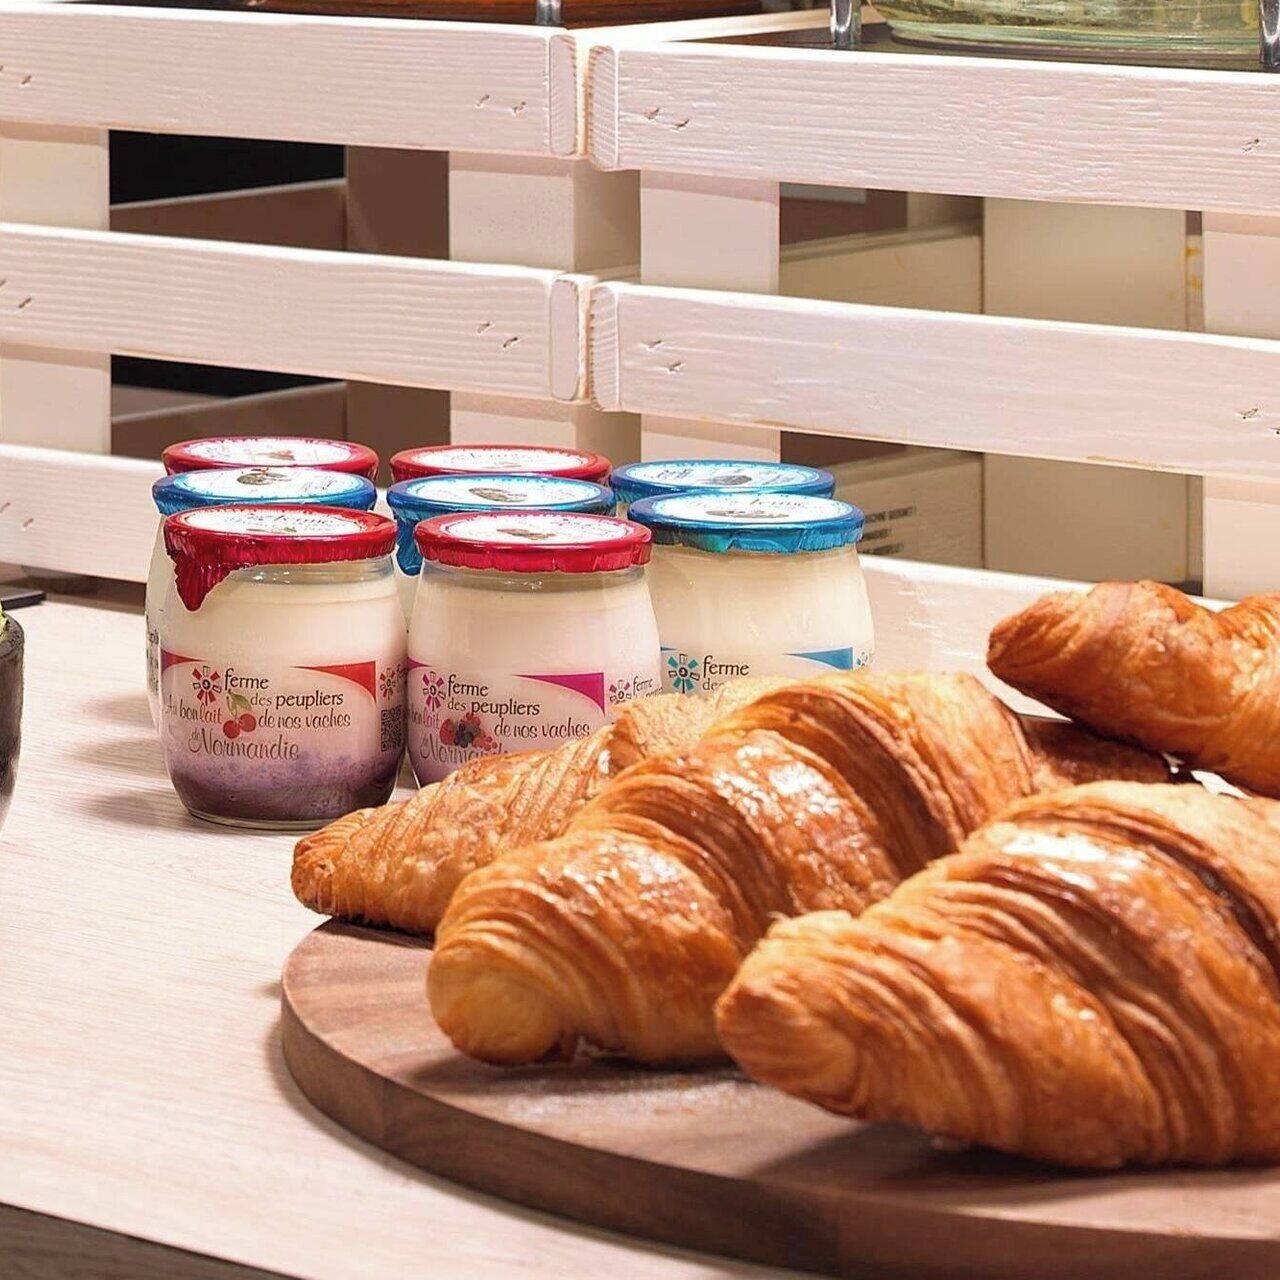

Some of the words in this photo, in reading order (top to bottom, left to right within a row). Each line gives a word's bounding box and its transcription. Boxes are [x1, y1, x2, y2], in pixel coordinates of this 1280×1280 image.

[702, 655, 750, 678] ferme
[224, 667, 269, 691] ferme
[447, 674, 489, 698] ferme
[250, 692, 272, 707] des
[276, 690, 344, 708] peupliers
[447, 697, 467, 712] des
[471, 697, 541, 718] peupliers
[179, 698, 199, 721] bon
[200, 702, 223, 725] lait
[258, 710, 276, 729] de
[277, 714, 302, 730] nos
[305, 706, 351, 730] vaches
[493, 719, 512, 739] de
[513, 722, 538, 739] nos
[541, 716, 591, 738] vaches
[188, 727, 300, 761] Normandie
